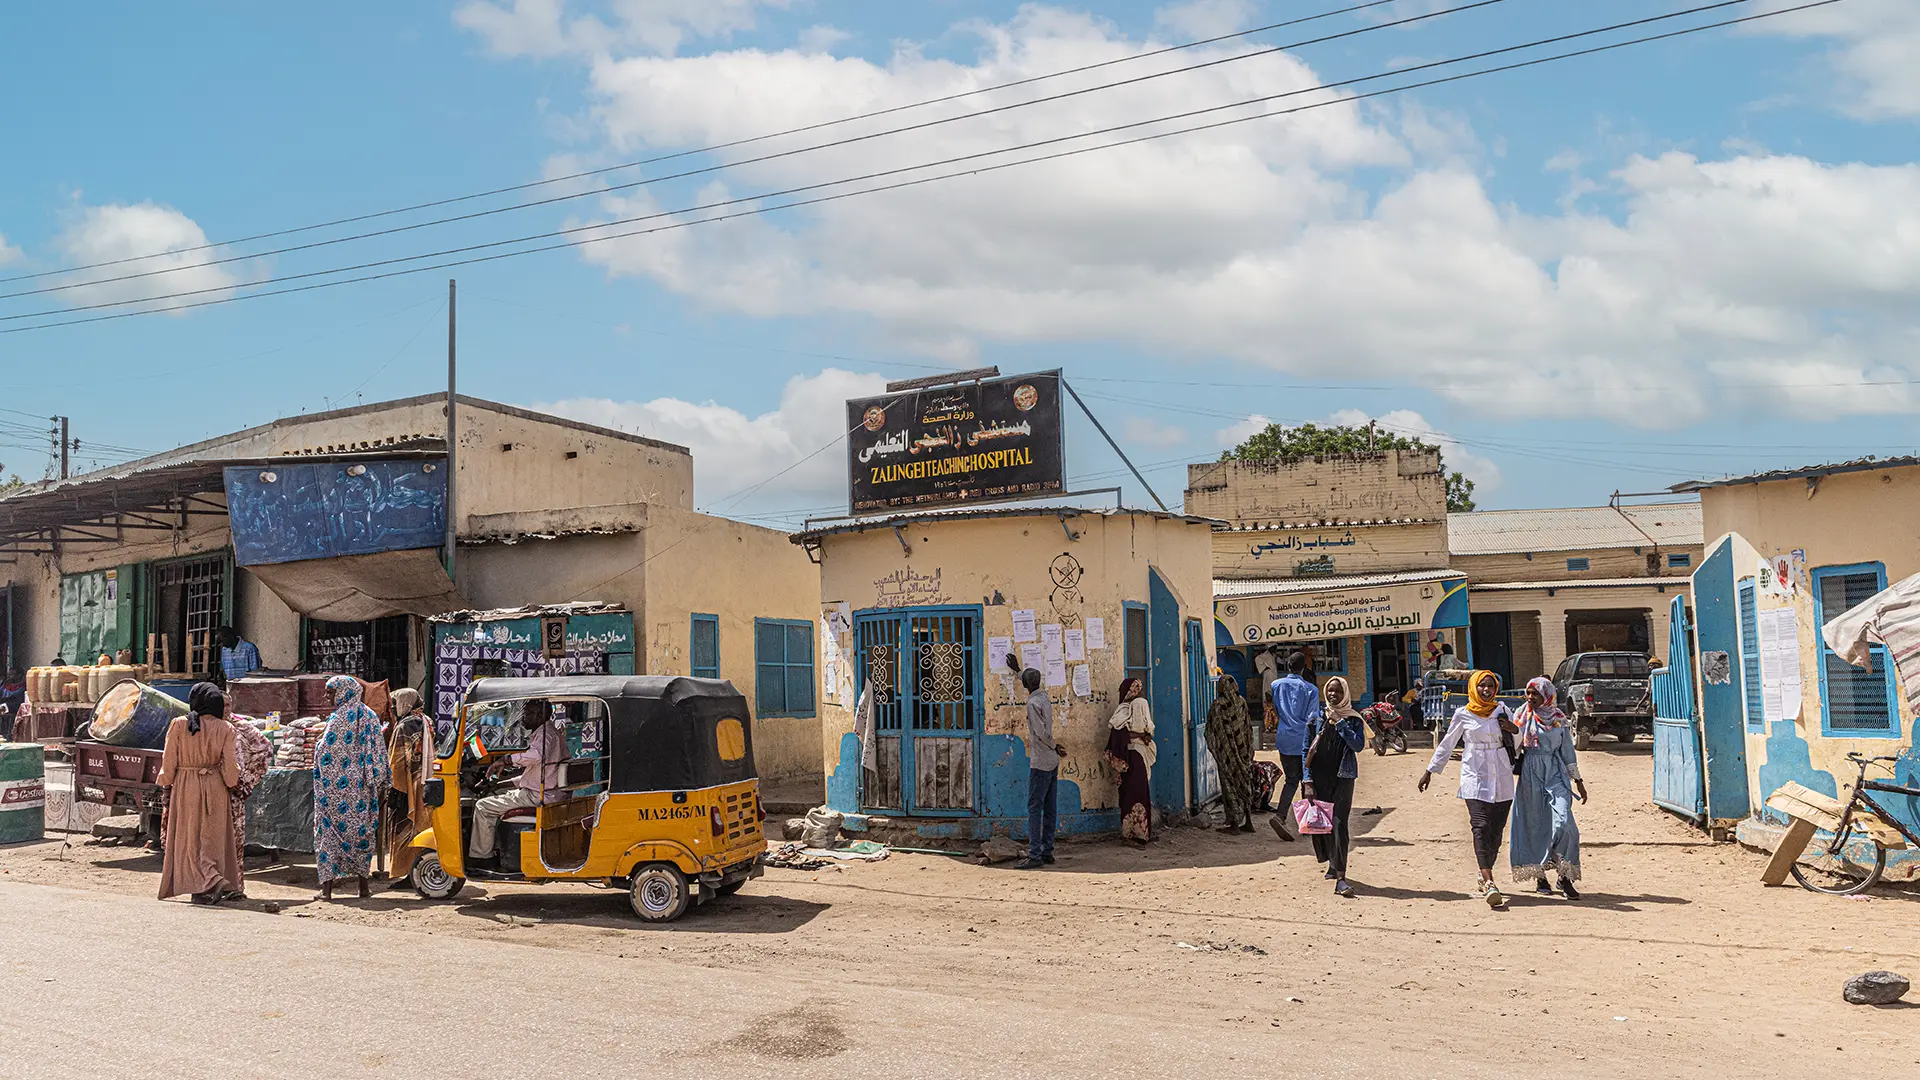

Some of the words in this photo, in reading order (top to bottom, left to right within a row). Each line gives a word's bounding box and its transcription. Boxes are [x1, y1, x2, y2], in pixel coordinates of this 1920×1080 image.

[922, 412, 952, 423] الصحة
[953, 410, 975, 421] وزارة
[871, 461, 925, 484] ZALINGEI
[970, 447, 1033, 472] HOSPITAL
[1250, 535, 1302, 560] زالنجي
[1303, 530, 1356, 550] شباب
[1269, 609, 1301, 621] National
[1302, 609, 1332, 618] Medical
[1334, 606, 1368, 618] Supplies
[1370, 604, 1391, 613] Fund
[1365, 612, 1420, 631] الصيدلية
[599, 629, 626, 645] محلات
[1248, 628, 1258, 640] 2
[1266, 623, 1293, 639] رقم
[638, 804, 707, 821] MA2465/M
